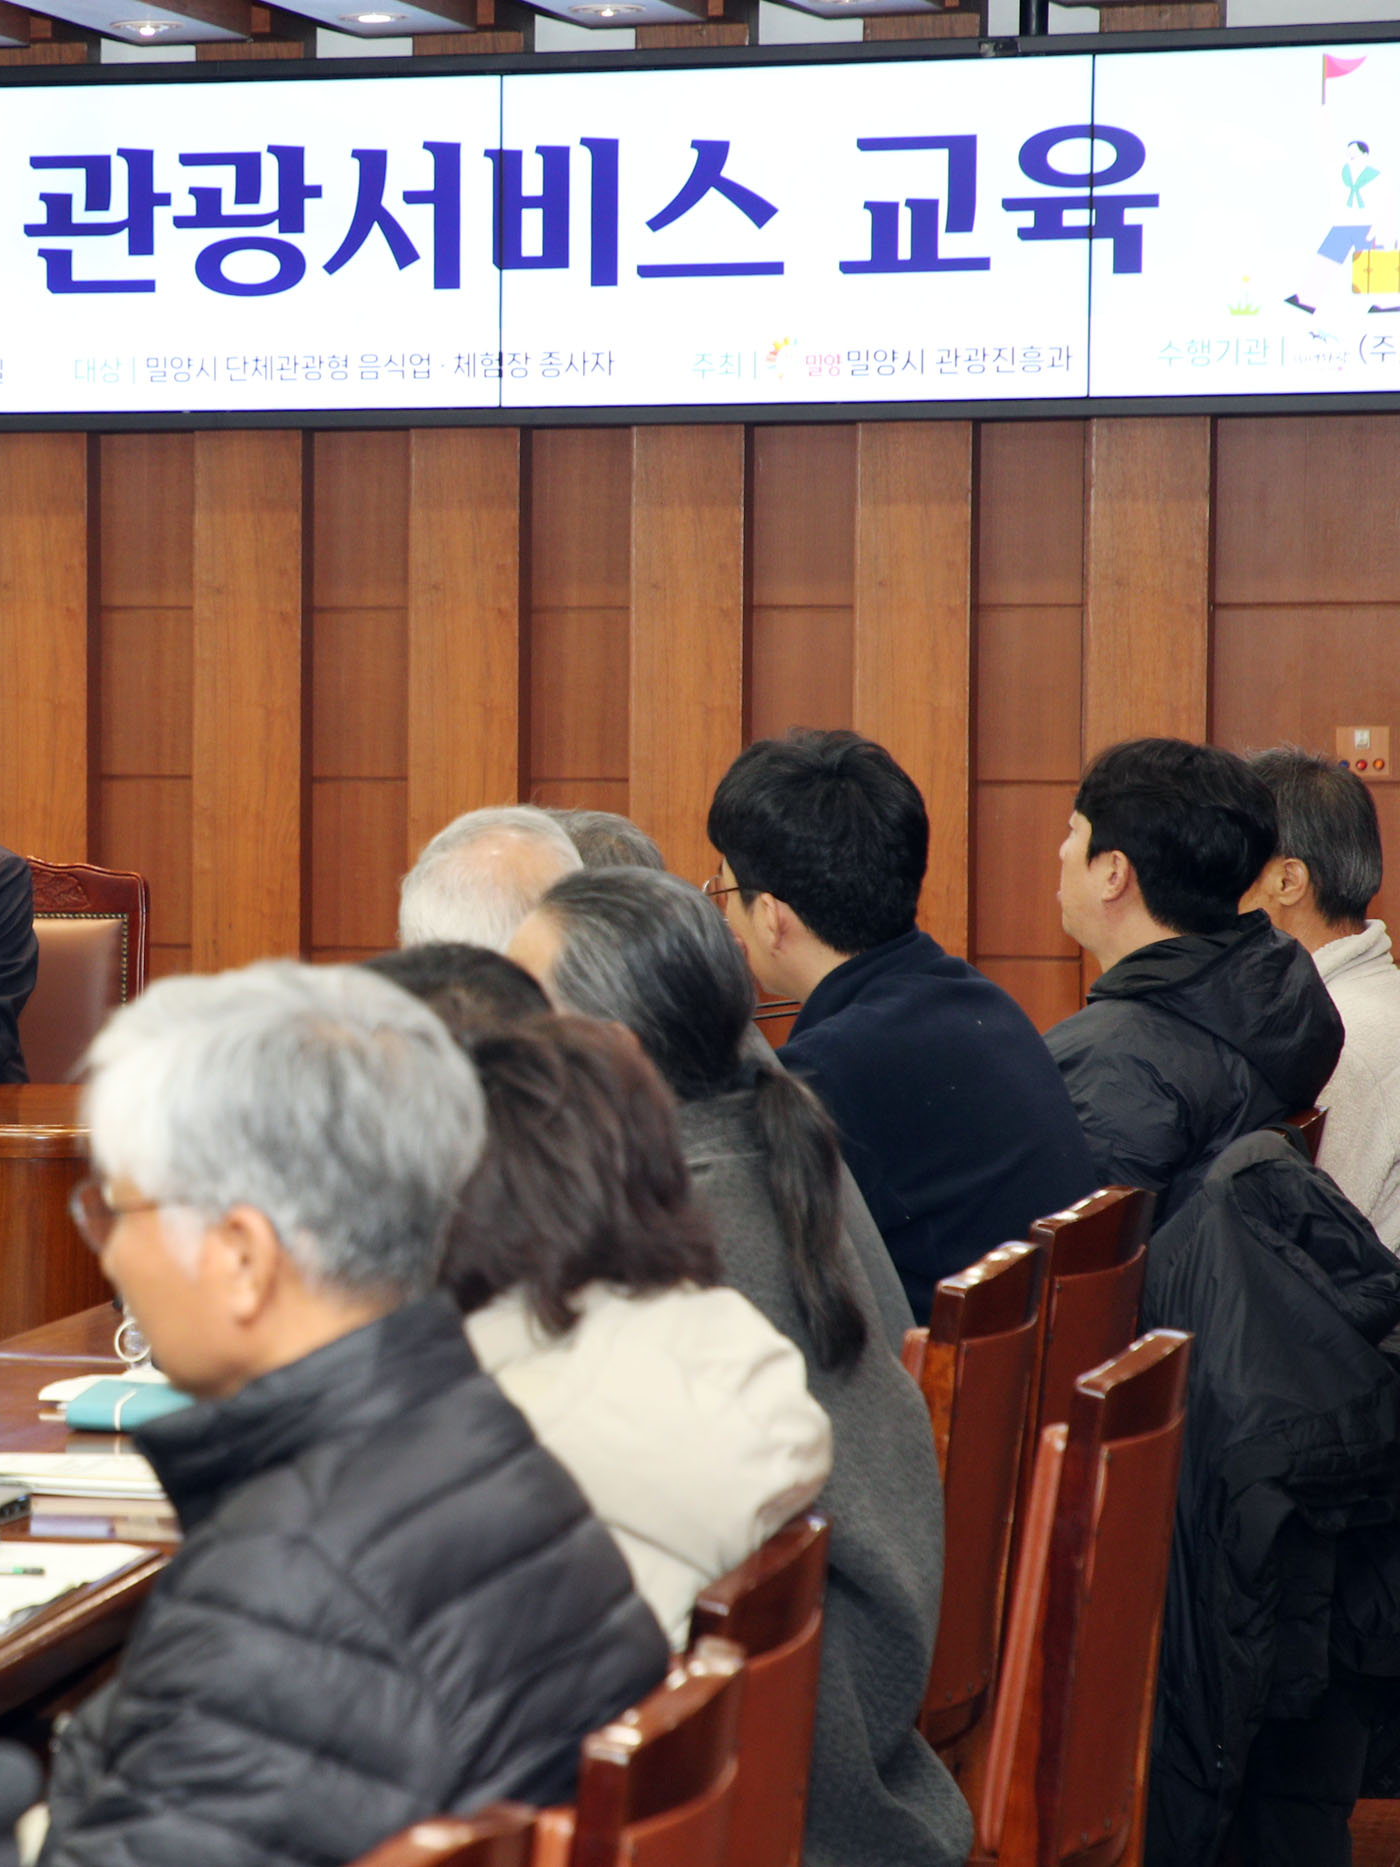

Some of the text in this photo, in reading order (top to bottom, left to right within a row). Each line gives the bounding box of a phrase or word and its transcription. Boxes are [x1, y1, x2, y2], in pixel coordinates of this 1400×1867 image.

[23, 123, 1160, 298] 관광서비스 교육
[73, 358, 122, 384] 대상
[146, 355, 217, 384] 밀양시
[226, 353, 349, 383] 단체관광형
[358, 352, 431, 381] 음식업
[454, 351, 531, 380] 체험장
[539, 350, 616, 379] 종사자
[691, 351, 743, 379] 주최
[846, 347, 925, 377] 밀양시
[935, 344, 1073, 375] 관광진흥과
[1158, 336, 1271, 369] 수행기관
